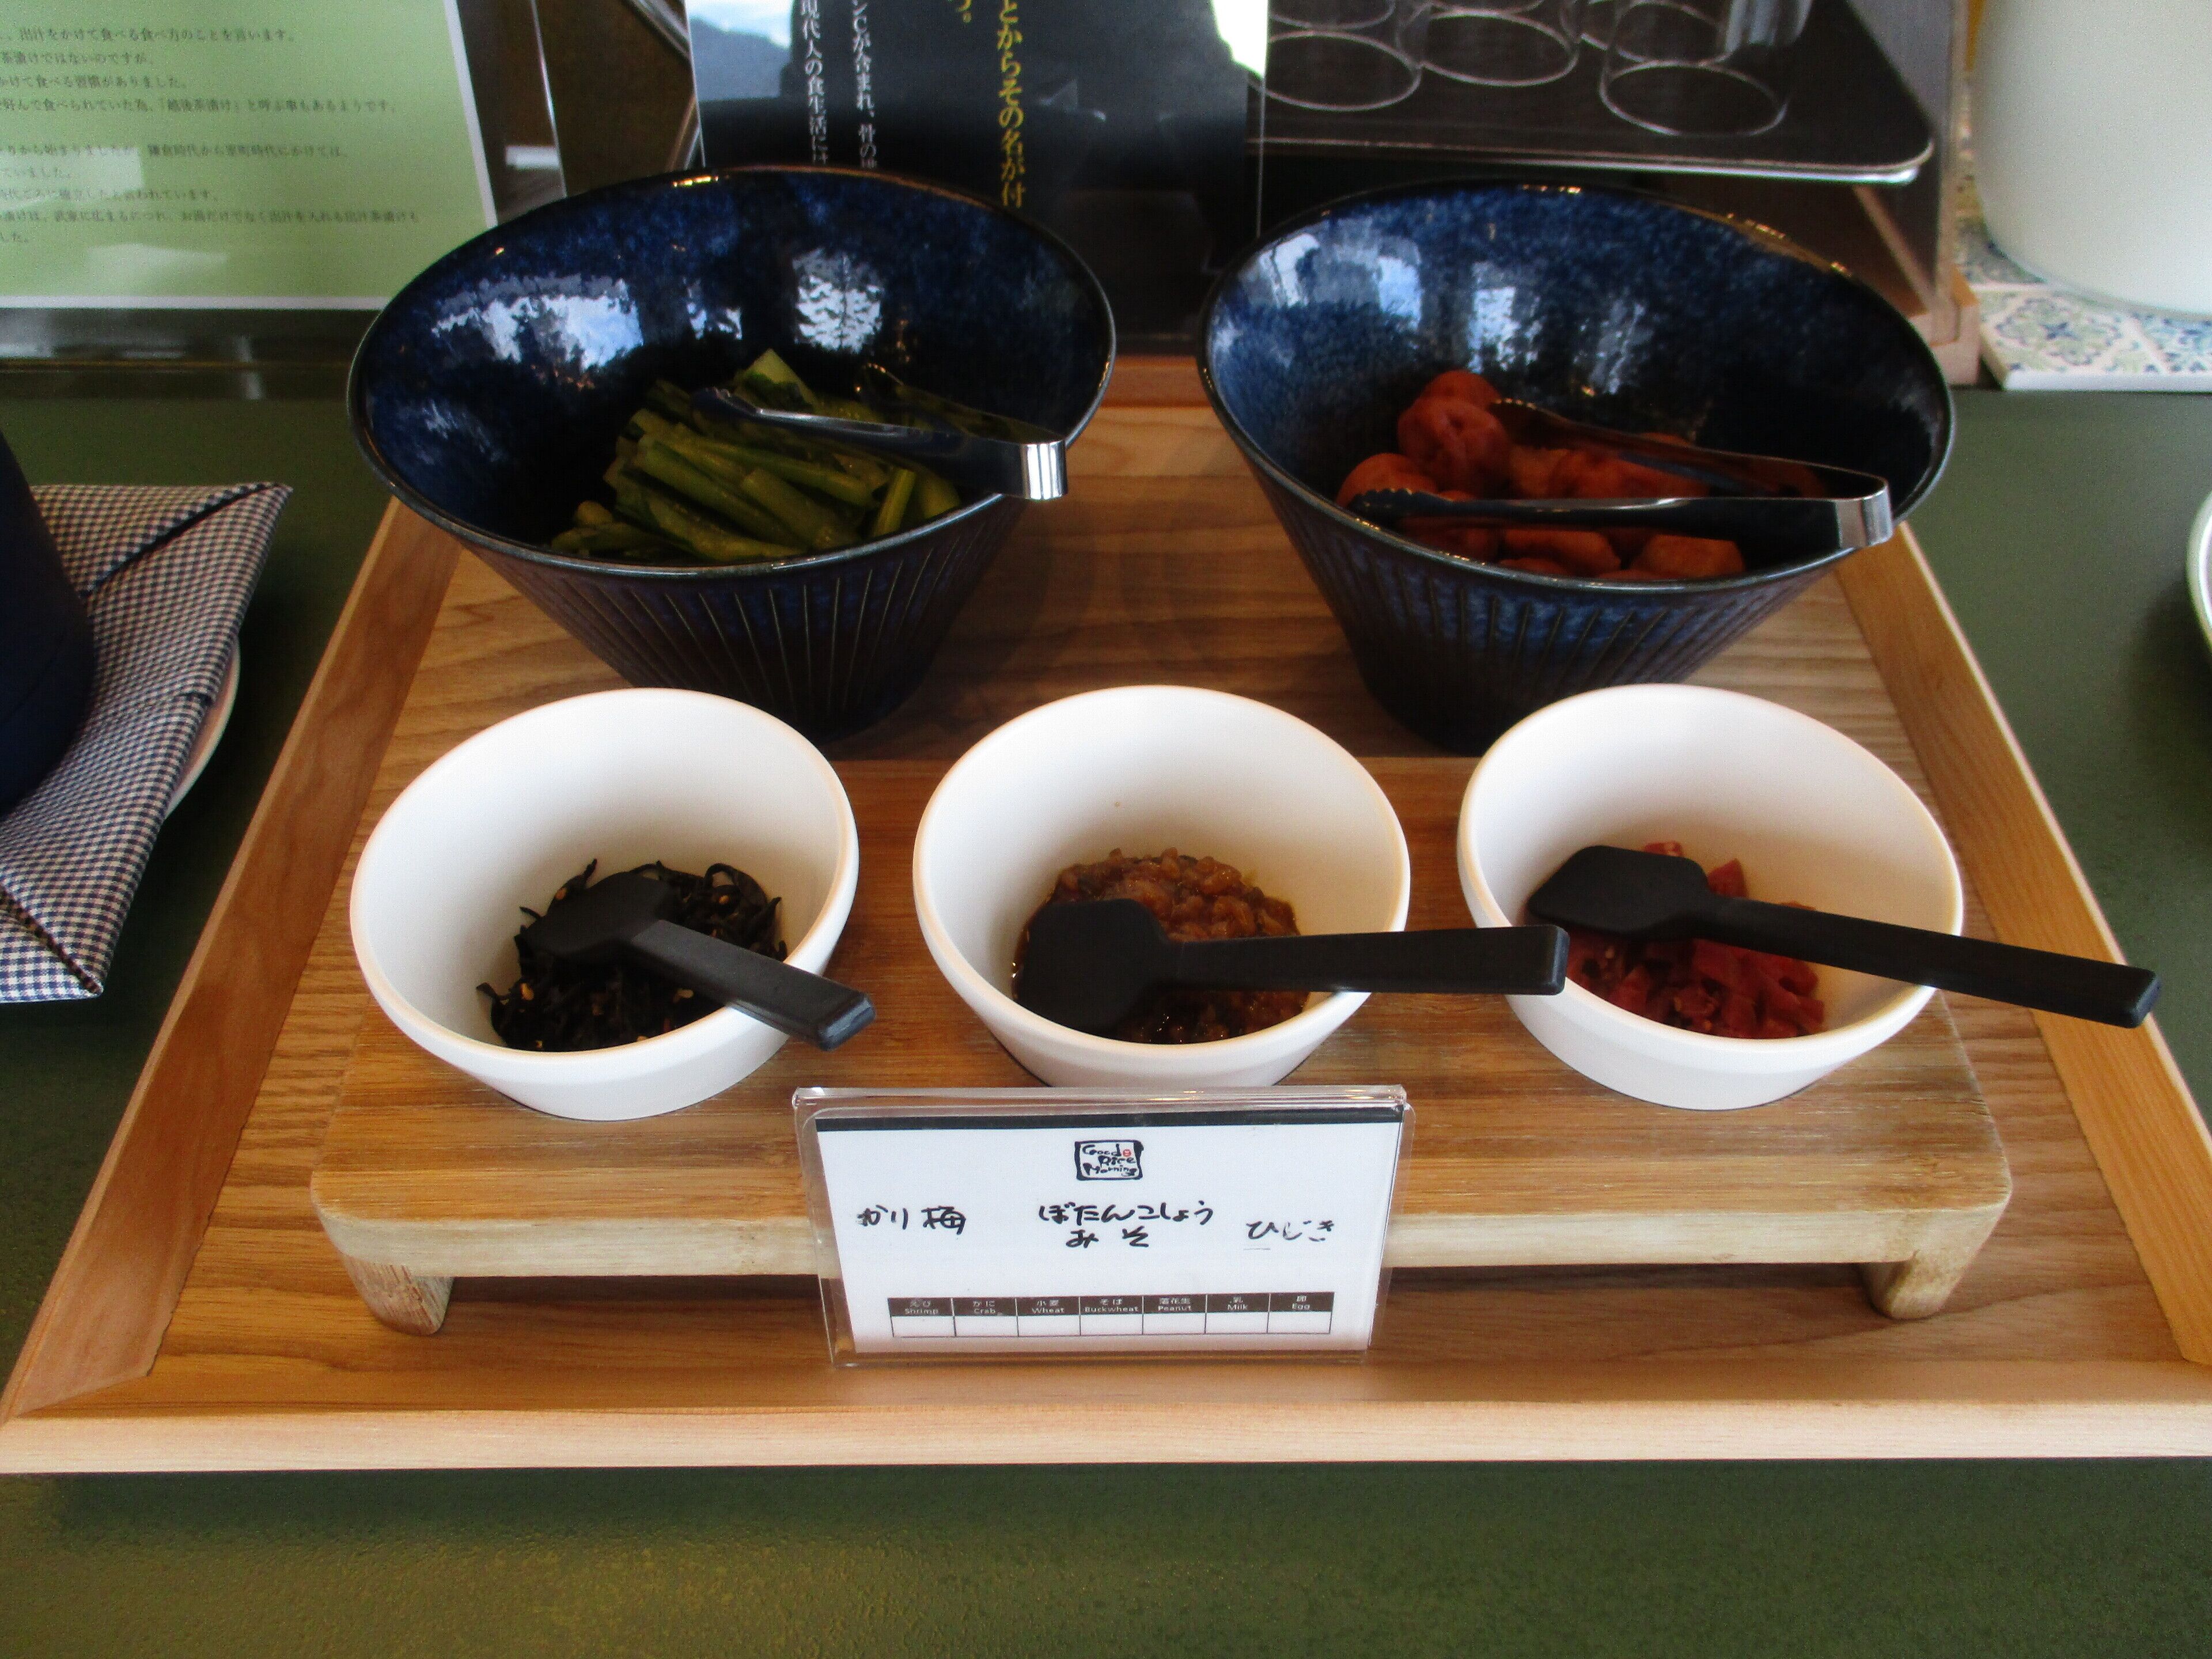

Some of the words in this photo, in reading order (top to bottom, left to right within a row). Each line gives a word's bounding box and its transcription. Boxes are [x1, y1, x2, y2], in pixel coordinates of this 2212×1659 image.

[1082, 1143, 1122, 1156] Good
[1082, 1162, 1137, 1176] Morning
[1098, 1155, 1136, 1167] Rice
[1039, 1200, 1213, 1225] ぼたんこしょう
[1066, 1225, 1149, 1248] みそ
[1246, 1220, 1334, 1242] ひじき
